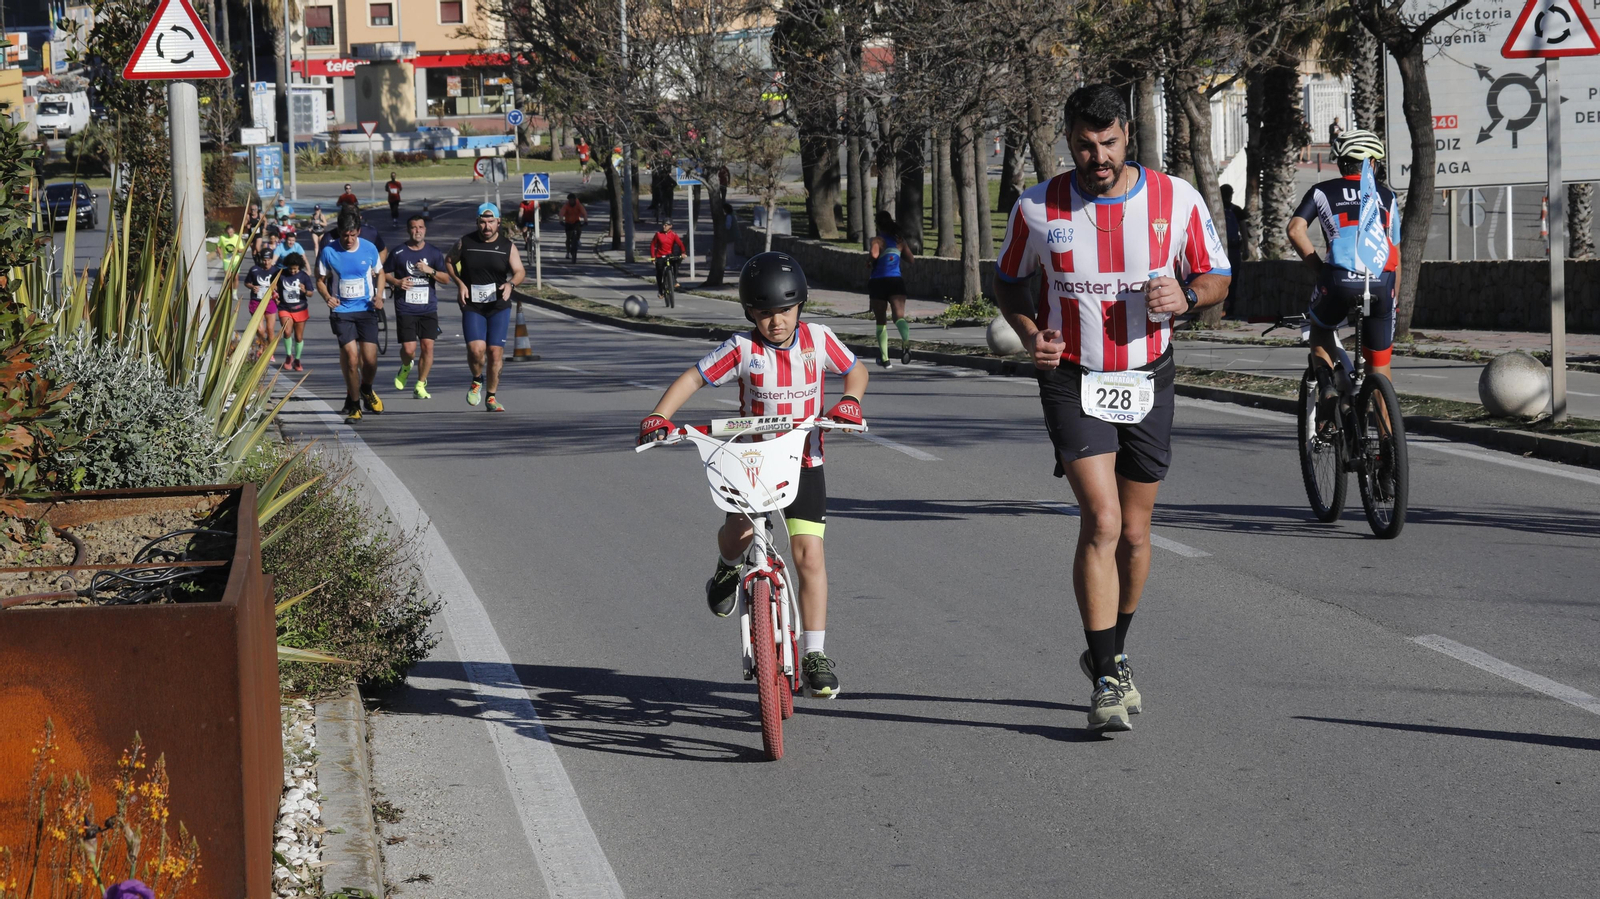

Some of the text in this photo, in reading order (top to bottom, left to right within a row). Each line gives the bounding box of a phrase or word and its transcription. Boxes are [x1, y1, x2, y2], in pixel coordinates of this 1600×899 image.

[1450, 8, 1512, 20] Victoria
[1423, 31, 1487, 46] Eugenia
[1431, 116, 1457, 128] 340
[1435, 137, 1461, 151] DIZ
[1401, 161, 1471, 176] MAGA
[1364, 236, 1379, 252] 1
[1373, 250, 1387, 269] 30
[1053, 278, 1146, 295] master.ho
[478, 291, 487, 299] 56
[749, 386, 818, 401] master.house
[1095, 388, 1132, 410] 228
